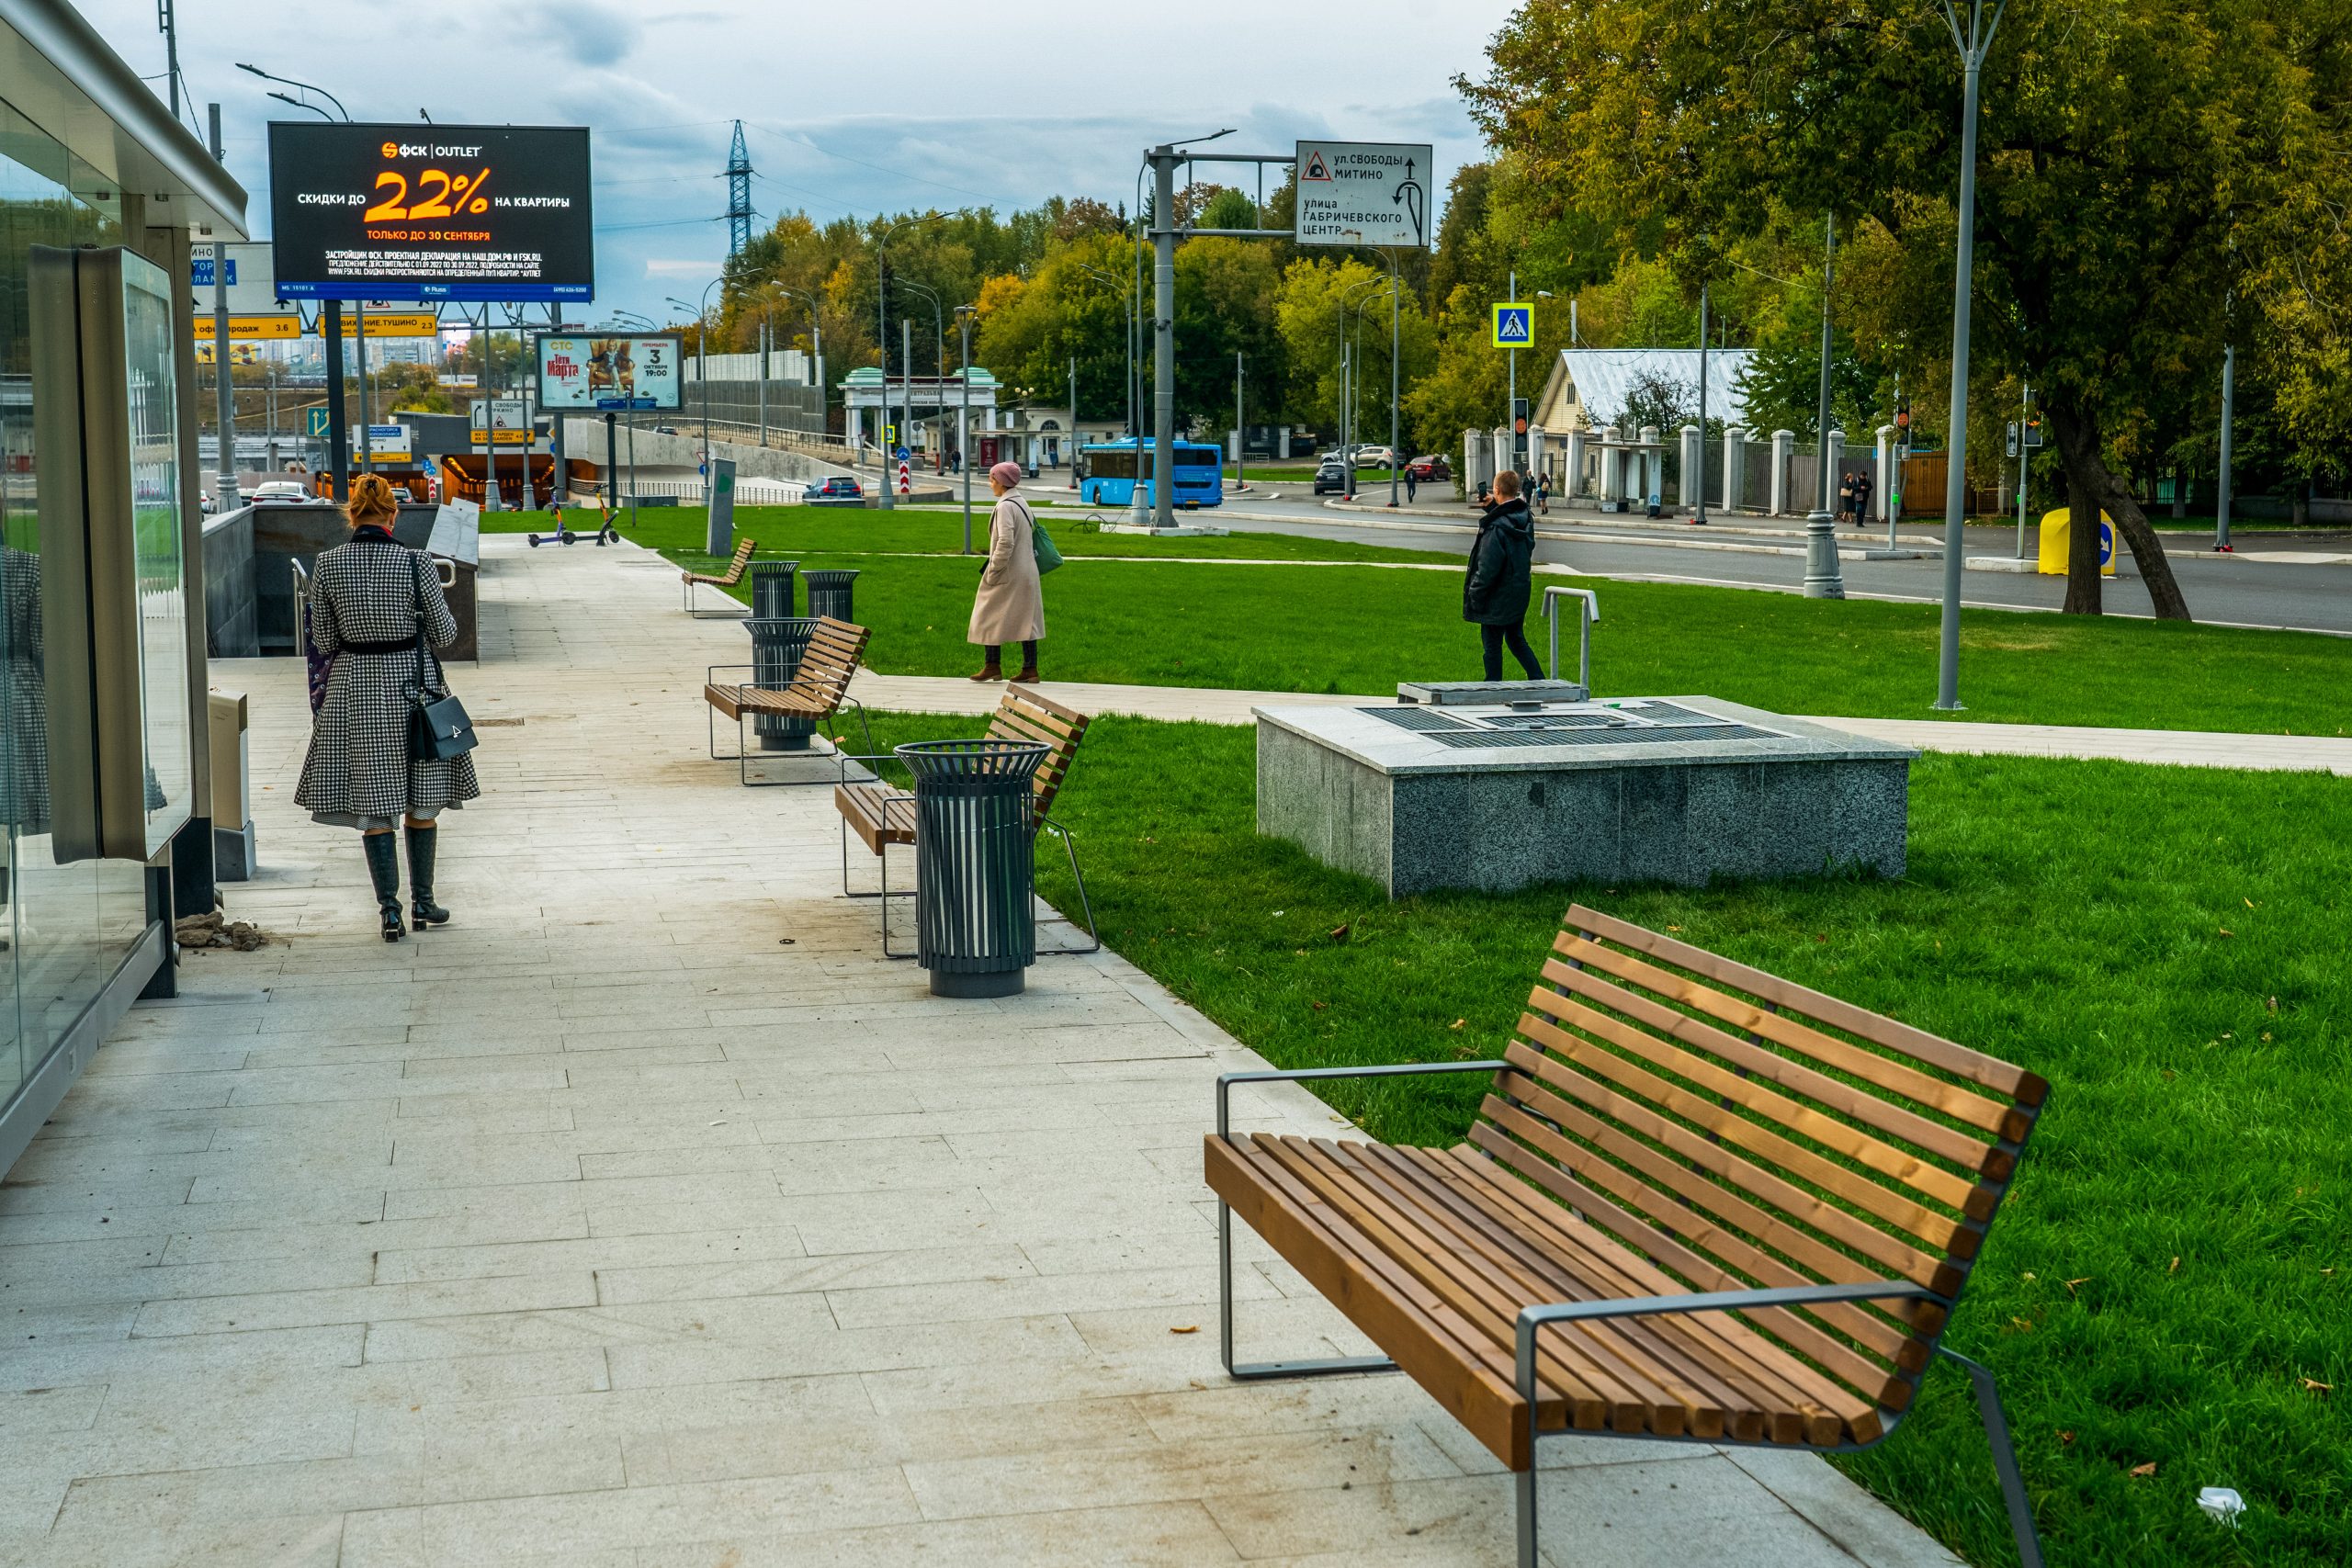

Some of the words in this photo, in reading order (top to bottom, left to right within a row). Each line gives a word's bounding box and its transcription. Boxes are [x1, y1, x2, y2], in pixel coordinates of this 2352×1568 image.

[399, 143, 427, 158] ФСК
[1335, 169, 1383, 180] МИТИНО
[298, 193, 345, 206] СКИДКИ
[347, 194, 366, 206] ДО
[364, 167, 491, 222] 22%
[494, 197, 512, 207] НА
[514, 197, 571, 208] КВАРТИРЫ
[1304, 198, 1338, 209] улица
[1303, 211, 1402, 223] ГАБРИЧЕВСКОГО
[1303, 224, 1342, 235] ЦЕНТР
[368, 231, 408, 240] ТОЛЬКО
[410, 231, 426, 241] ДО
[428, 231, 441, 241] 30
[443, 231, 491, 242] СЕНТЯБРЯ
[325, 250, 368, 260] ЗАСТРОЙЩИК
[384, 251, 420, 260] ПРОЕКТНАЯ
[421, 252, 461, 261] ДЕКЛАРАЦИЯ
[368, 260, 410, 268] ДЕЙСТВИТЕЛЬНО
[229, 324, 259, 333] родаж
[550, 341, 573, 351] СТС
[650, 349, 661, 364] 3
[548, 360, 579, 380] Марта
